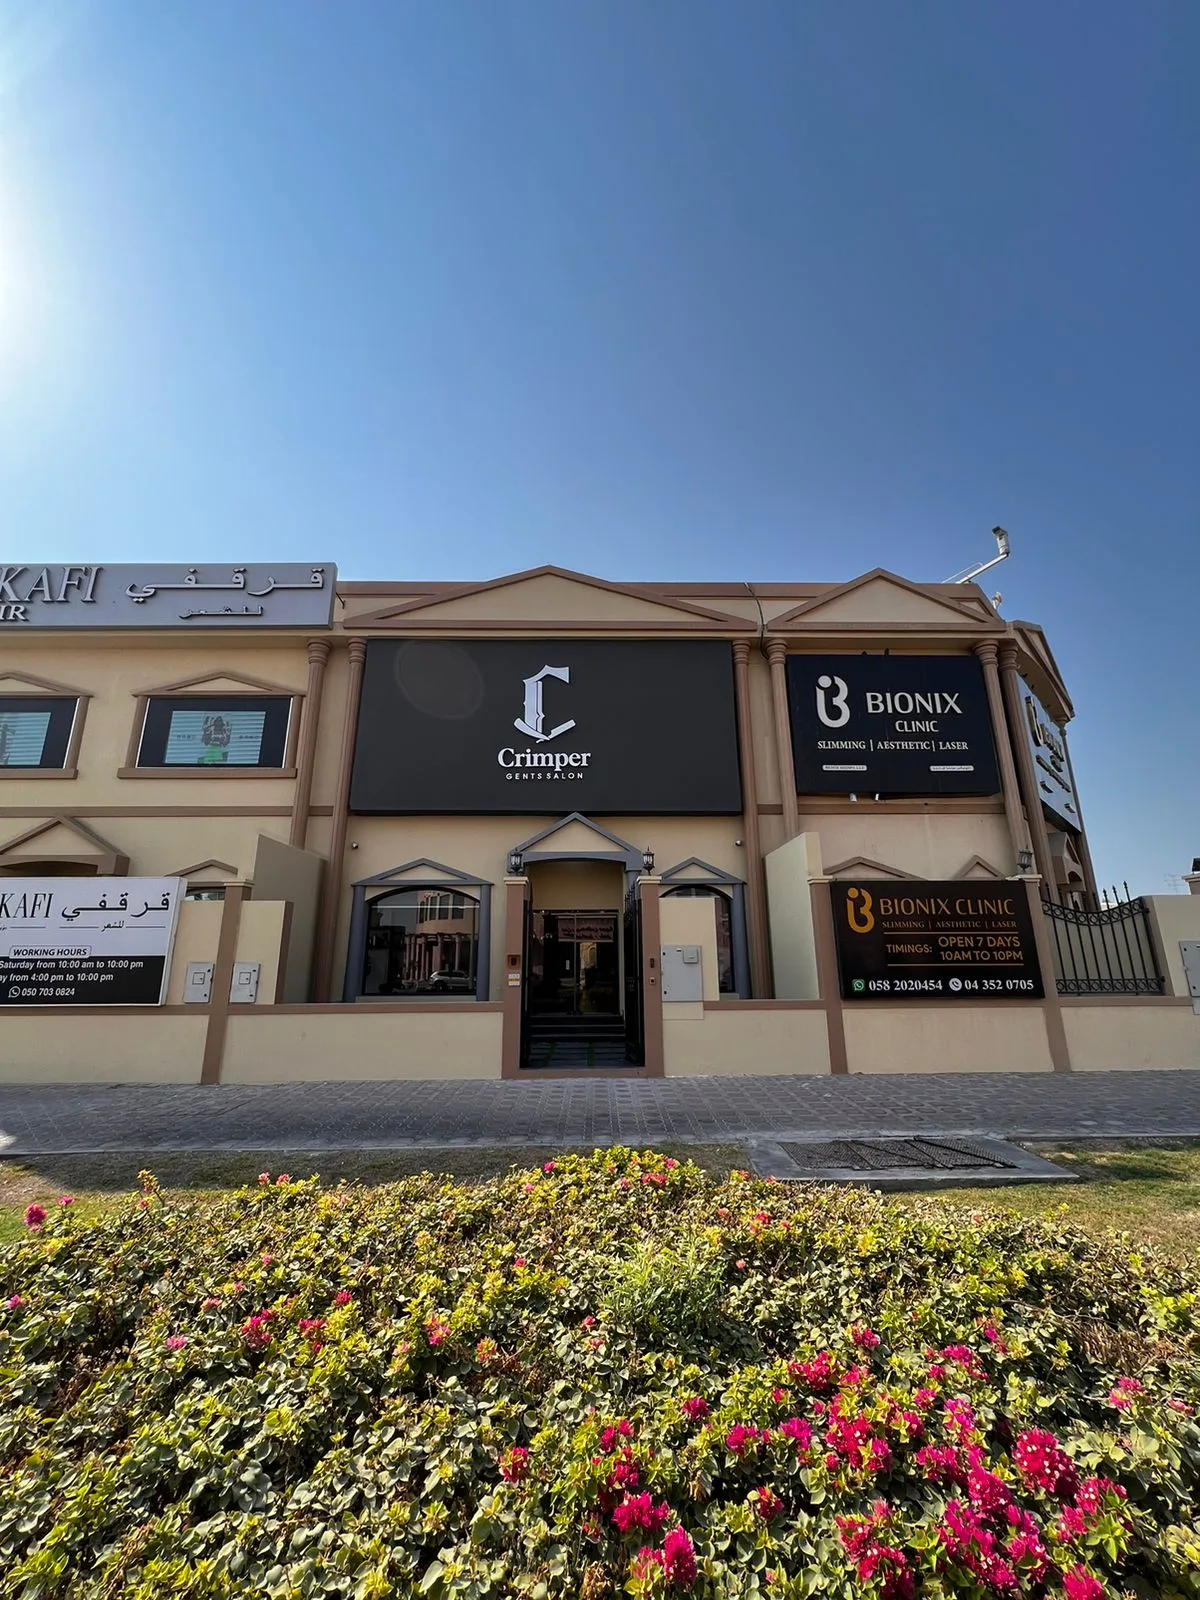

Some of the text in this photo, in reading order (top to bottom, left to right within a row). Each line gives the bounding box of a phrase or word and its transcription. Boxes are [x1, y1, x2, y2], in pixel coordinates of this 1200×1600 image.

[0, 566, 101, 602] KAFI
[865, 692, 962, 714] BIONIX
[895, 720, 939, 732] CLINIC
[817, 740, 969, 750] SLIMMING AESTHETIC LASER
[497, 747, 592, 772] Crimper
[0, 892, 54, 918] KAFI
[879, 898, 1016, 916] BIONIX CLINIC
[881, 920, 1017, 929] SLIMMING AESTHETIC LASER
[938, 936, 1021, 948] OPEN 7 DAYS
[13, 948, 88, 956] WORKING HOURS
[886, 943, 933, 954] TIMINGS:
[940, 950, 1024, 961] 10AM TO 10PM
[0, 960, 35, 971] Saturday
[36, 960, 56, 969] from
[59, 960, 80, 969] 10:00
[96, 960, 105, 968] to
[107, 960, 129, 968] 10:00
[130, 961, 144, 970] pm
[10, 973, 29, 981] from
[31, 973, 49, 981] 4:00
[50, 974, 64, 983] pm
[65, 973, 75, 981] to
[77, 972, 99, 981] 10:00
[99, 974, 114, 983] pm
[868, 979, 943, 991] 058 2020454
[964, 979, 1034, 991] 04 352 0705
[21, 987, 76, 996] 050 703 0824
